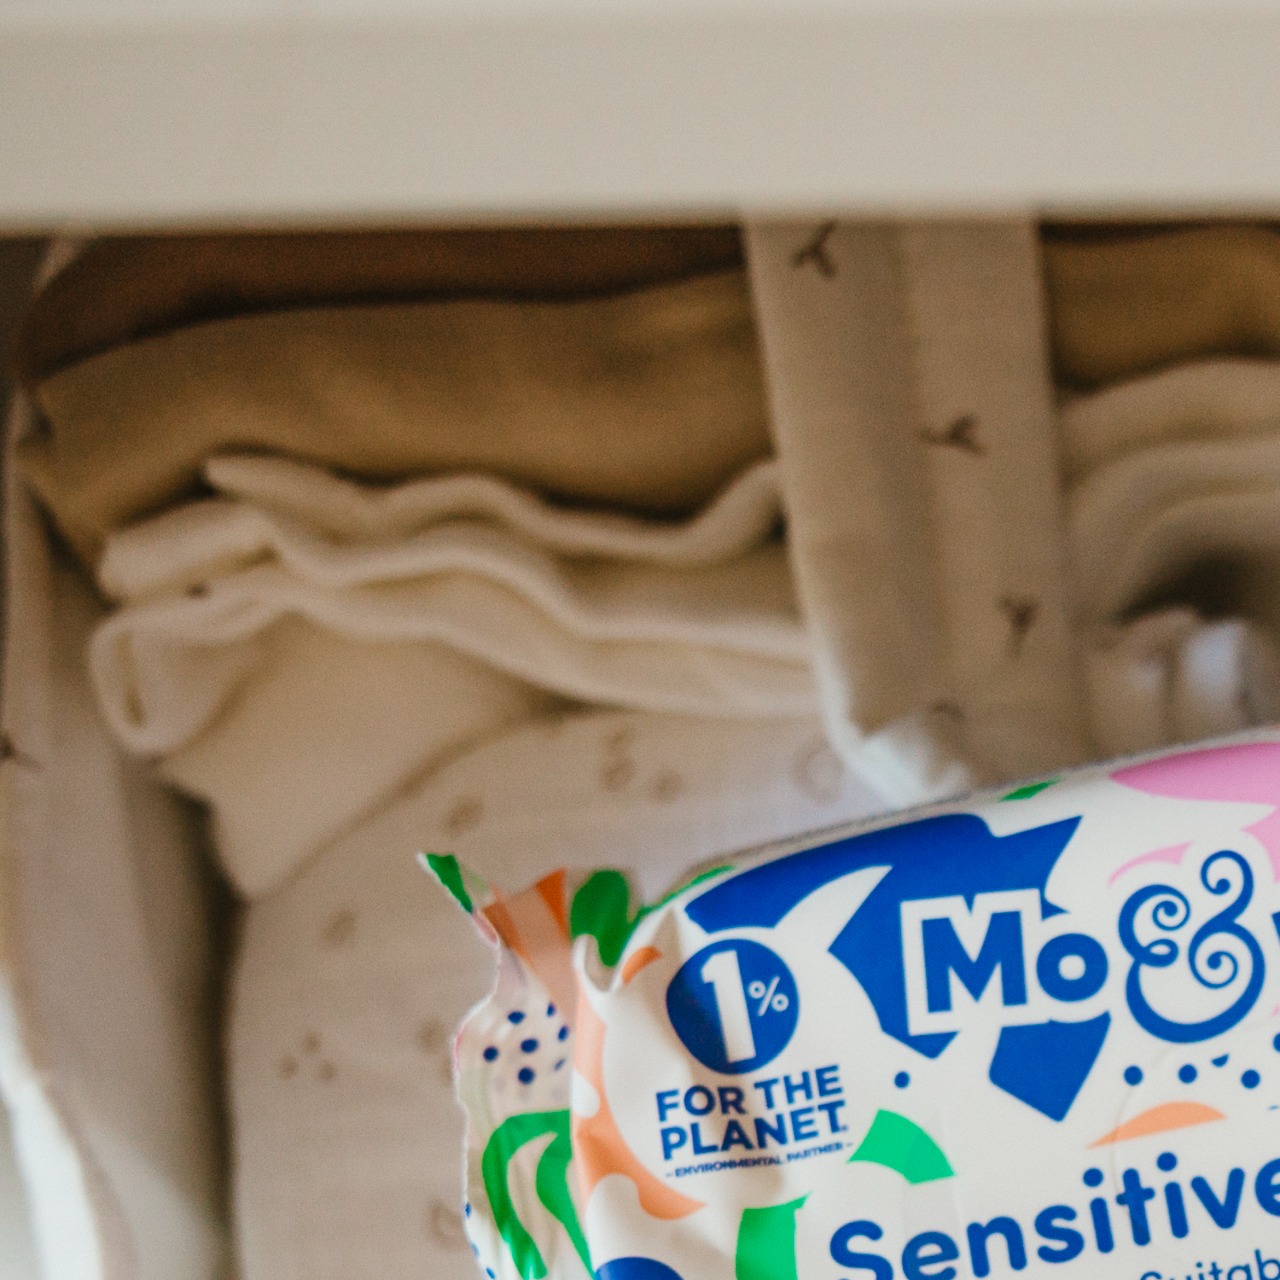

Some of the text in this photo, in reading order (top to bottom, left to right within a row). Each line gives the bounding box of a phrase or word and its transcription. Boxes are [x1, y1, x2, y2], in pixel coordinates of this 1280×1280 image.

[919, 908, 1109, 1015] Mo
[1117, 849, 1267, 1043] &
[655, 1063, 844, 1123] FOR THE
